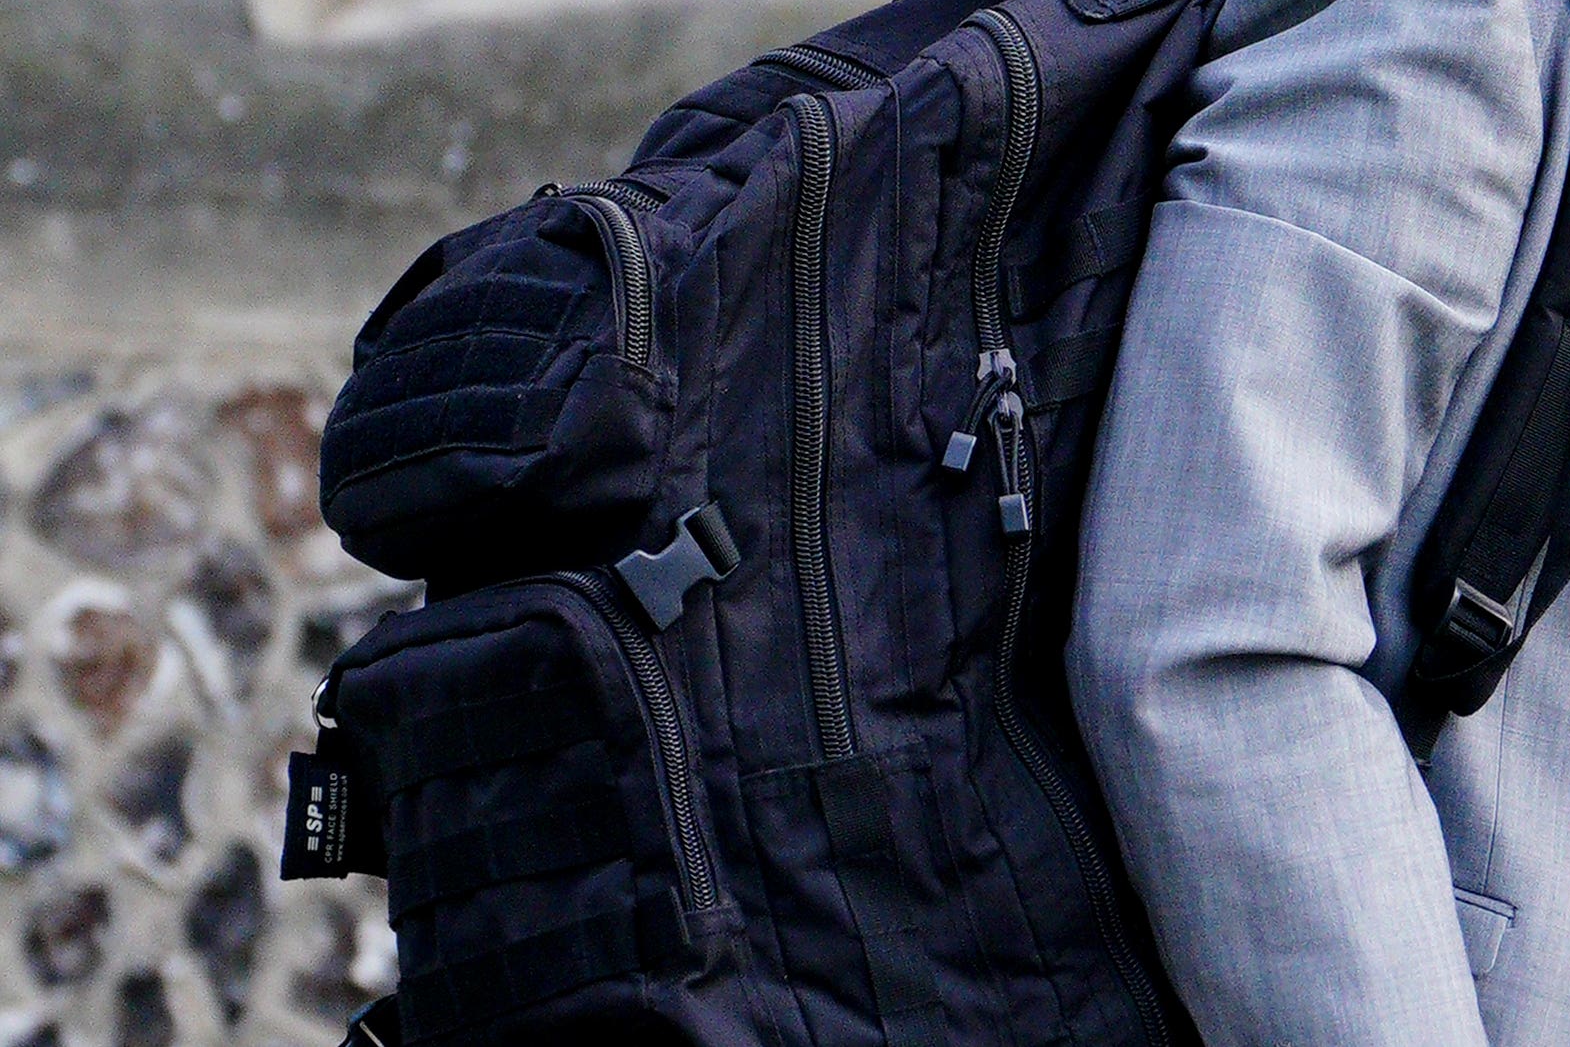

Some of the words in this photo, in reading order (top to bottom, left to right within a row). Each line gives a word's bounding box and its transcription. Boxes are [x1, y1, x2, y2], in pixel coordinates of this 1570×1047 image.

[329, 773, 338, 810] SHIELD
[306, 804, 323, 833] SP
[326, 814, 337, 840] FACE
[324, 843, 334, 863] CPR
